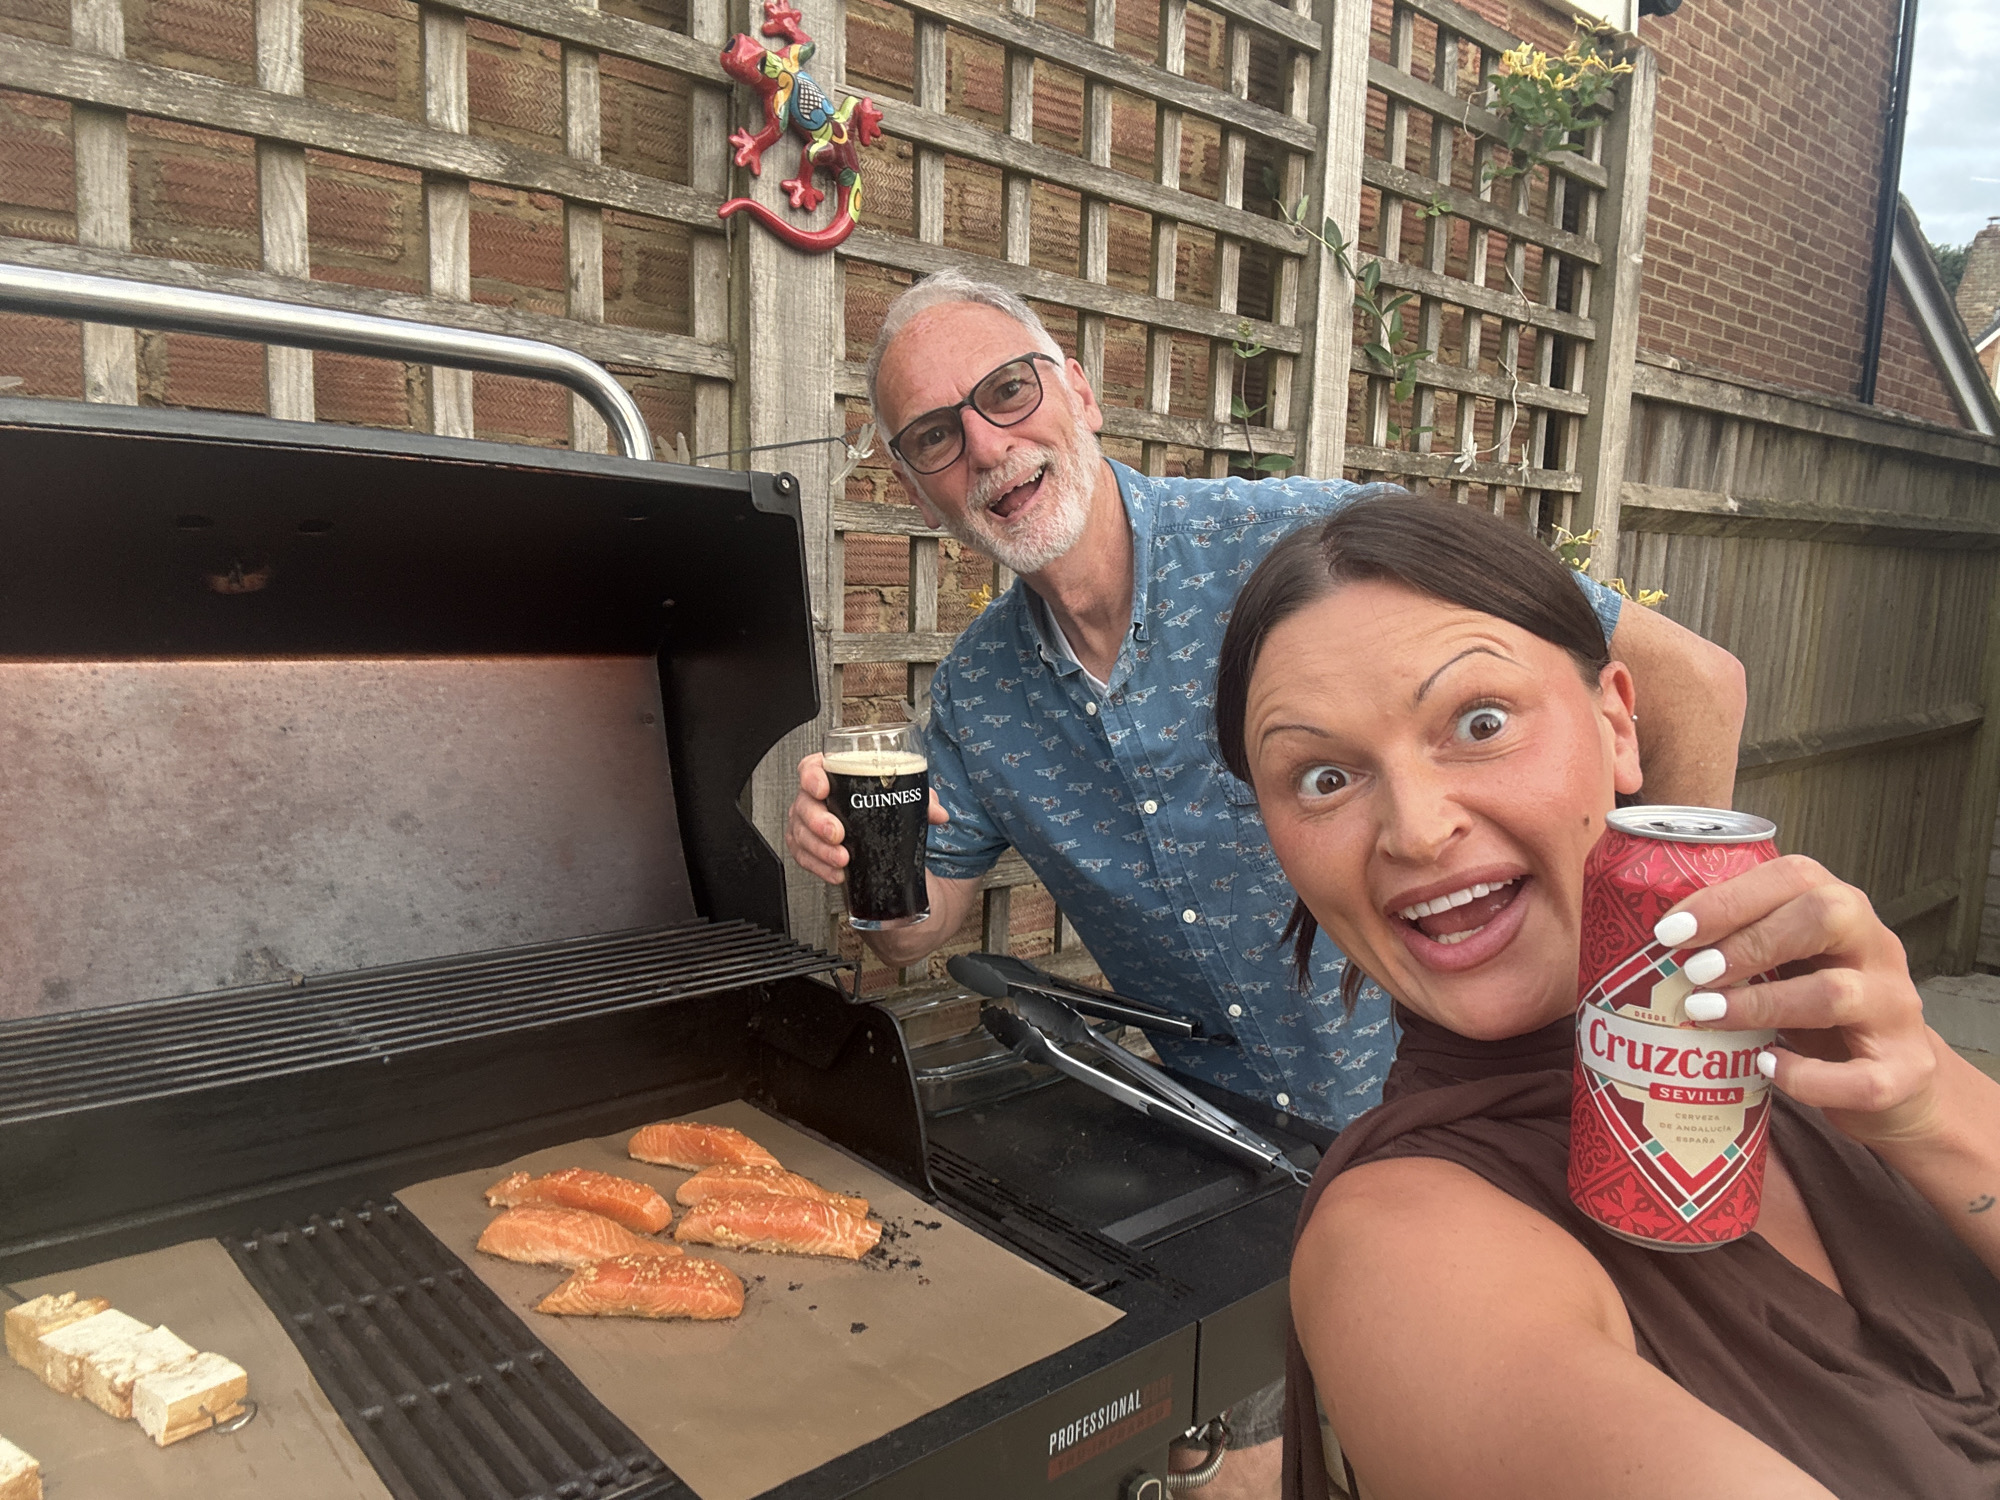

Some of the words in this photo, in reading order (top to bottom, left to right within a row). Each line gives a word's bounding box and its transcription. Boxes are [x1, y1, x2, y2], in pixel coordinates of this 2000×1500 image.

[850, 788, 922, 809] GUINNESS
[1634, 1010, 1667, 1023] DESDE
[1589, 1017, 1774, 1081] Cruzcam
[1659, 1087, 1736, 1102] SEVILLA
[1674, 1112, 1721, 1121] CERVEZA
[1659, 1122, 1673, 1130] DE
[1676, 1123, 1732, 1133] ANDALUCÍA
[1676, 1134, 1716, 1144] ESPAÑA
[1048, 1388, 1142, 1456] PROFESSIONAL
